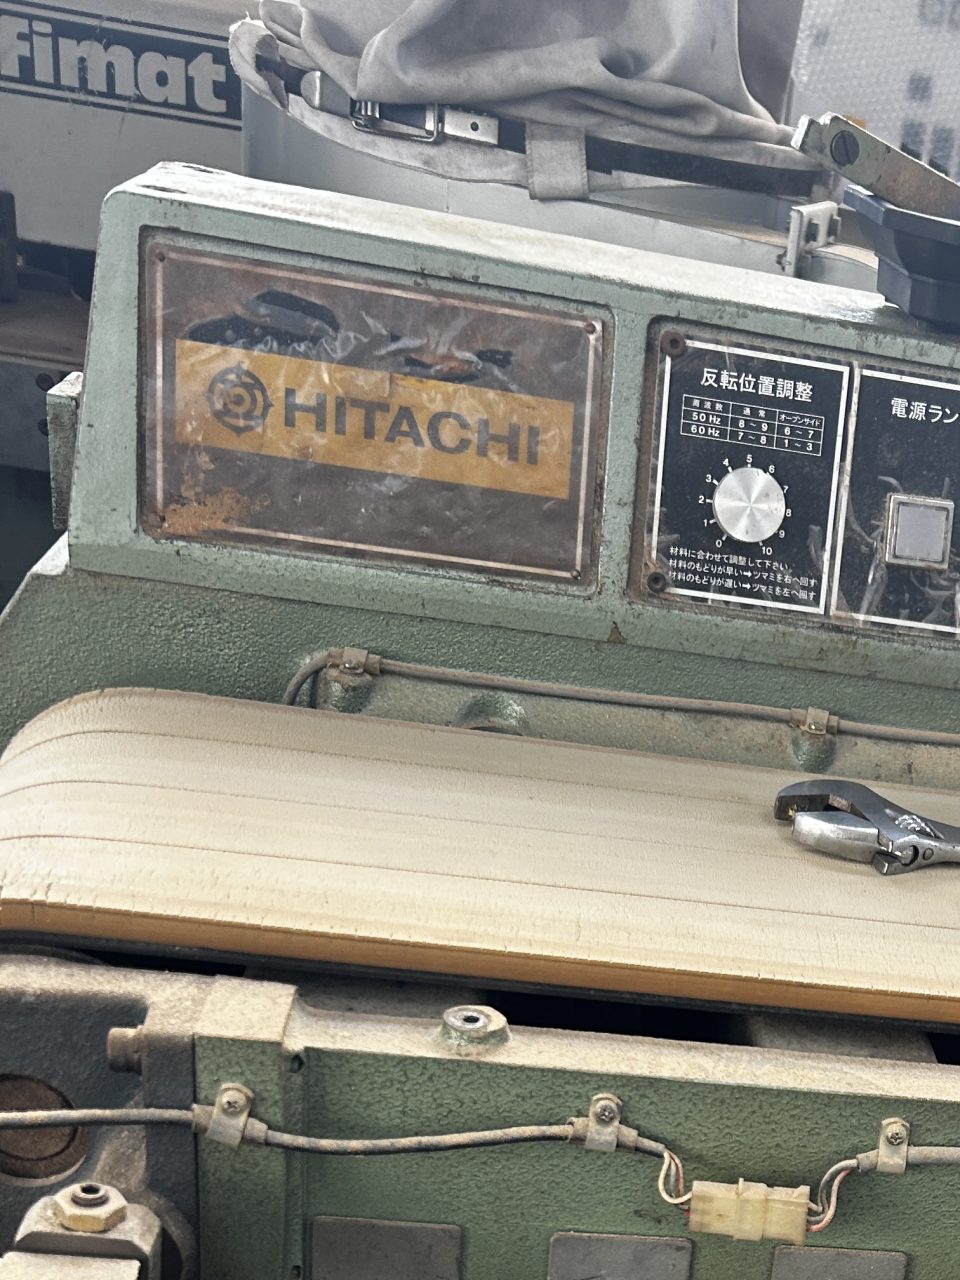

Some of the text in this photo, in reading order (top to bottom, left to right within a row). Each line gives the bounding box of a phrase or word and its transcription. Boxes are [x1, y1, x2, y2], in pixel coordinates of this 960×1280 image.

[0, 15, 227, 113] fimat
[700, 367, 813, 402] 反転位置調整
[692, 412, 706, 423] 50
[779, 413, 822, 427] オープンサイド
[283, 388, 541, 466] HITACHI
[690, 425, 705, 435] 60
[722, 458, 729, 466] 4
[746, 454, 753, 463] 5
[768, 465, 776, 474] 6
[705, 474, 712, 483] 3
[783, 485, 790, 493] 7
[698, 495, 705, 504] 2
[785, 509, 792, 517] 8
[779, 530, 785, 538] 9
[715, 539, 722, 548] 0
[761, 546, 773, 556] 10
